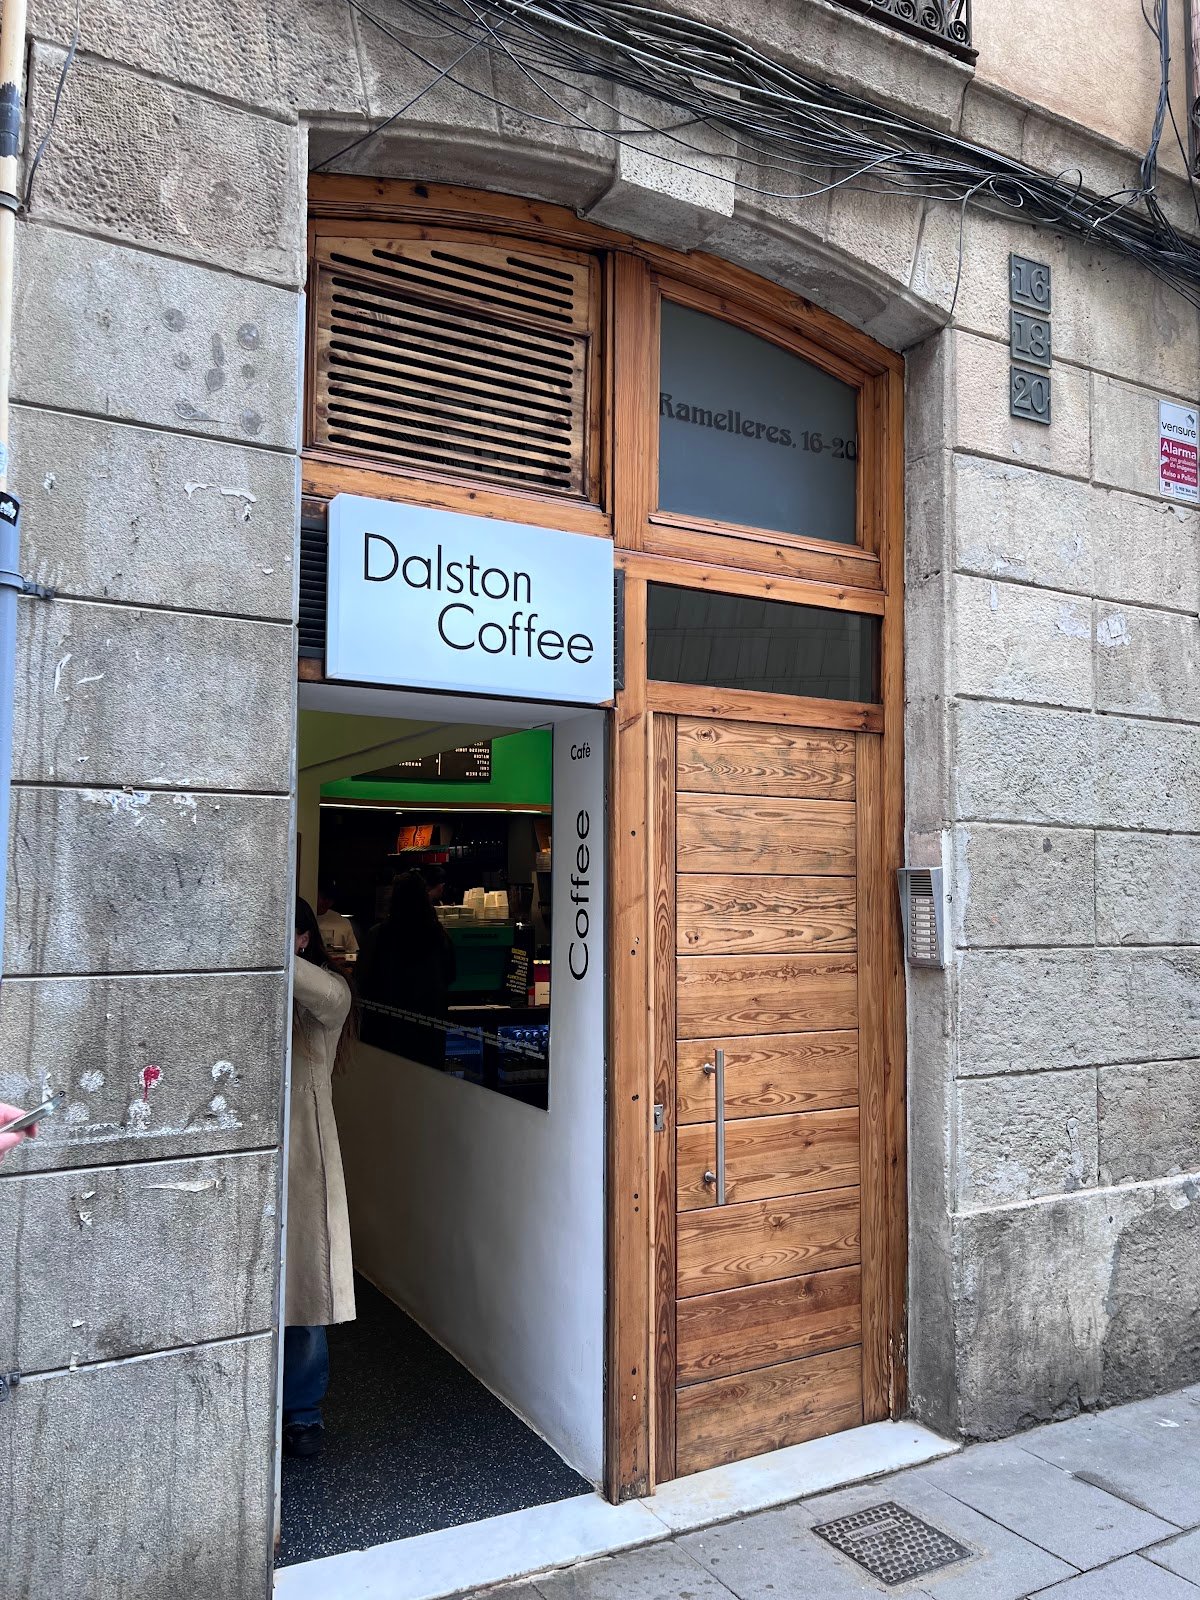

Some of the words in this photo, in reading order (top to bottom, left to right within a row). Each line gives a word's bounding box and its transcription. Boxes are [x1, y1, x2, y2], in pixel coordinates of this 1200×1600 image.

[1015, 263, 1047, 303] 16
[1015, 319, 1046, 358] 18
[1013, 374, 1046, 414] 20
[801, 430, 857, 461] 16-20
[1161, 421, 1196, 438] verisure
[1161, 441, 1197, 460] Alarma
[1162, 469, 1176, 478] Aviso
[364, 532, 532, 604] Dalston
[437, 602, 594, 664] Coffee
[568, 809, 590, 981] Coffee
